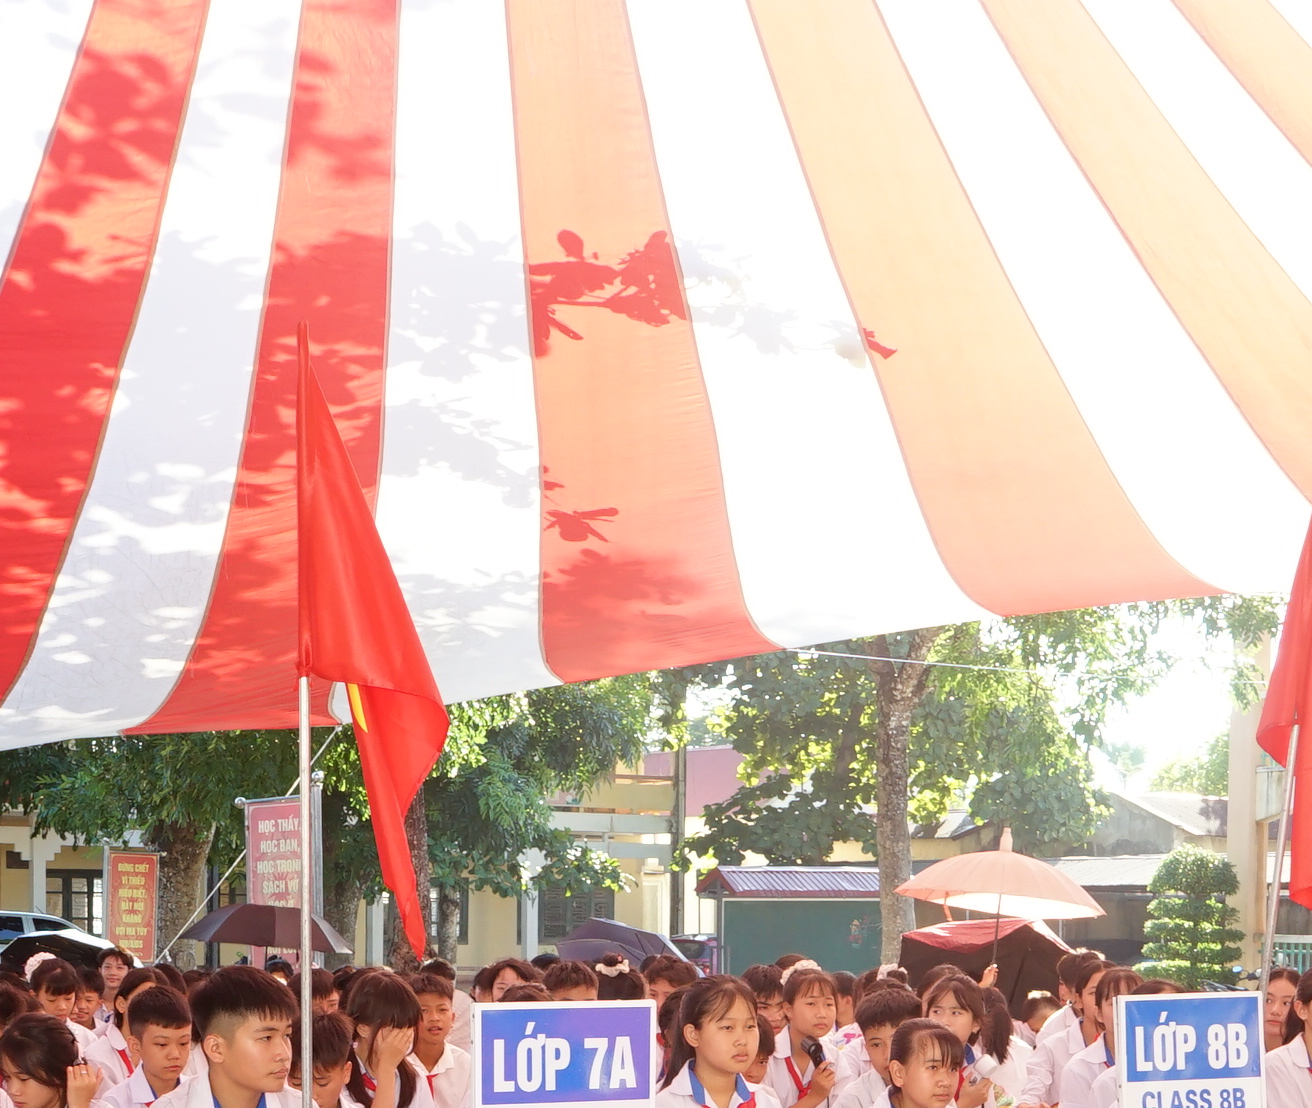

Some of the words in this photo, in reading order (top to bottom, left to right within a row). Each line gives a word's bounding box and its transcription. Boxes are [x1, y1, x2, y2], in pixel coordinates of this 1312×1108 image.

[258, 820, 275, 836] HỌC
[260, 840, 277, 856] HỌC
[257, 860, 274, 876] HỌC
[1135, 1011, 1197, 1072] LỚP
[1207, 1023, 1249, 1070] 8B
[493, 1021, 571, 1093] LỚP
[584, 1036, 637, 1090] 7A
